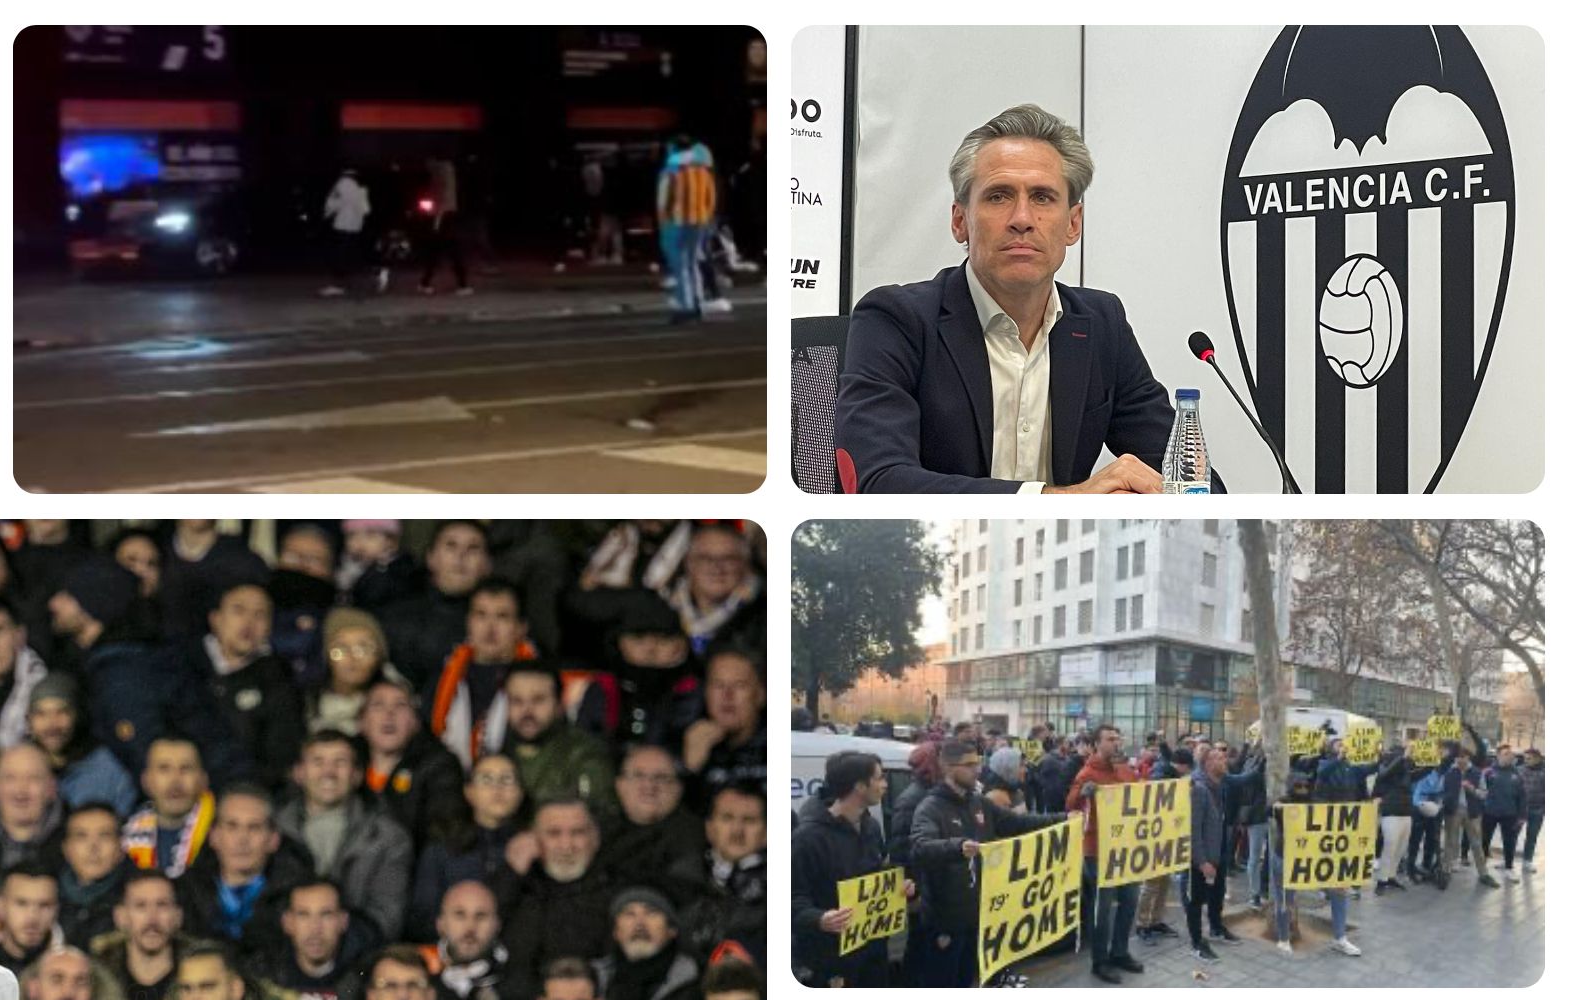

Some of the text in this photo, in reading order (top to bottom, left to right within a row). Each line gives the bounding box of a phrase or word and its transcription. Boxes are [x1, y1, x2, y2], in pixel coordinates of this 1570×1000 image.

[1243, 163, 1490, 216] VALENCIA C.F.
[1121, 781, 1178, 817] LIM
[1134, 817, 1163, 841] GO
[1305, 804, 1362, 832] LIM
[1009, 824, 1071, 883] LIM
[1104, 834, 1191, 881] HOME
[1317, 835, 1349, 854] GO
[857, 871, 896, 903] LIM
[1290, 853, 1375, 885] HOME
[866, 897, 888, 916] GO
[1022, 873, 1055, 909] GO
[843, 908, 905, 951] HOME
[983, 888, 1079, 971] HOME
